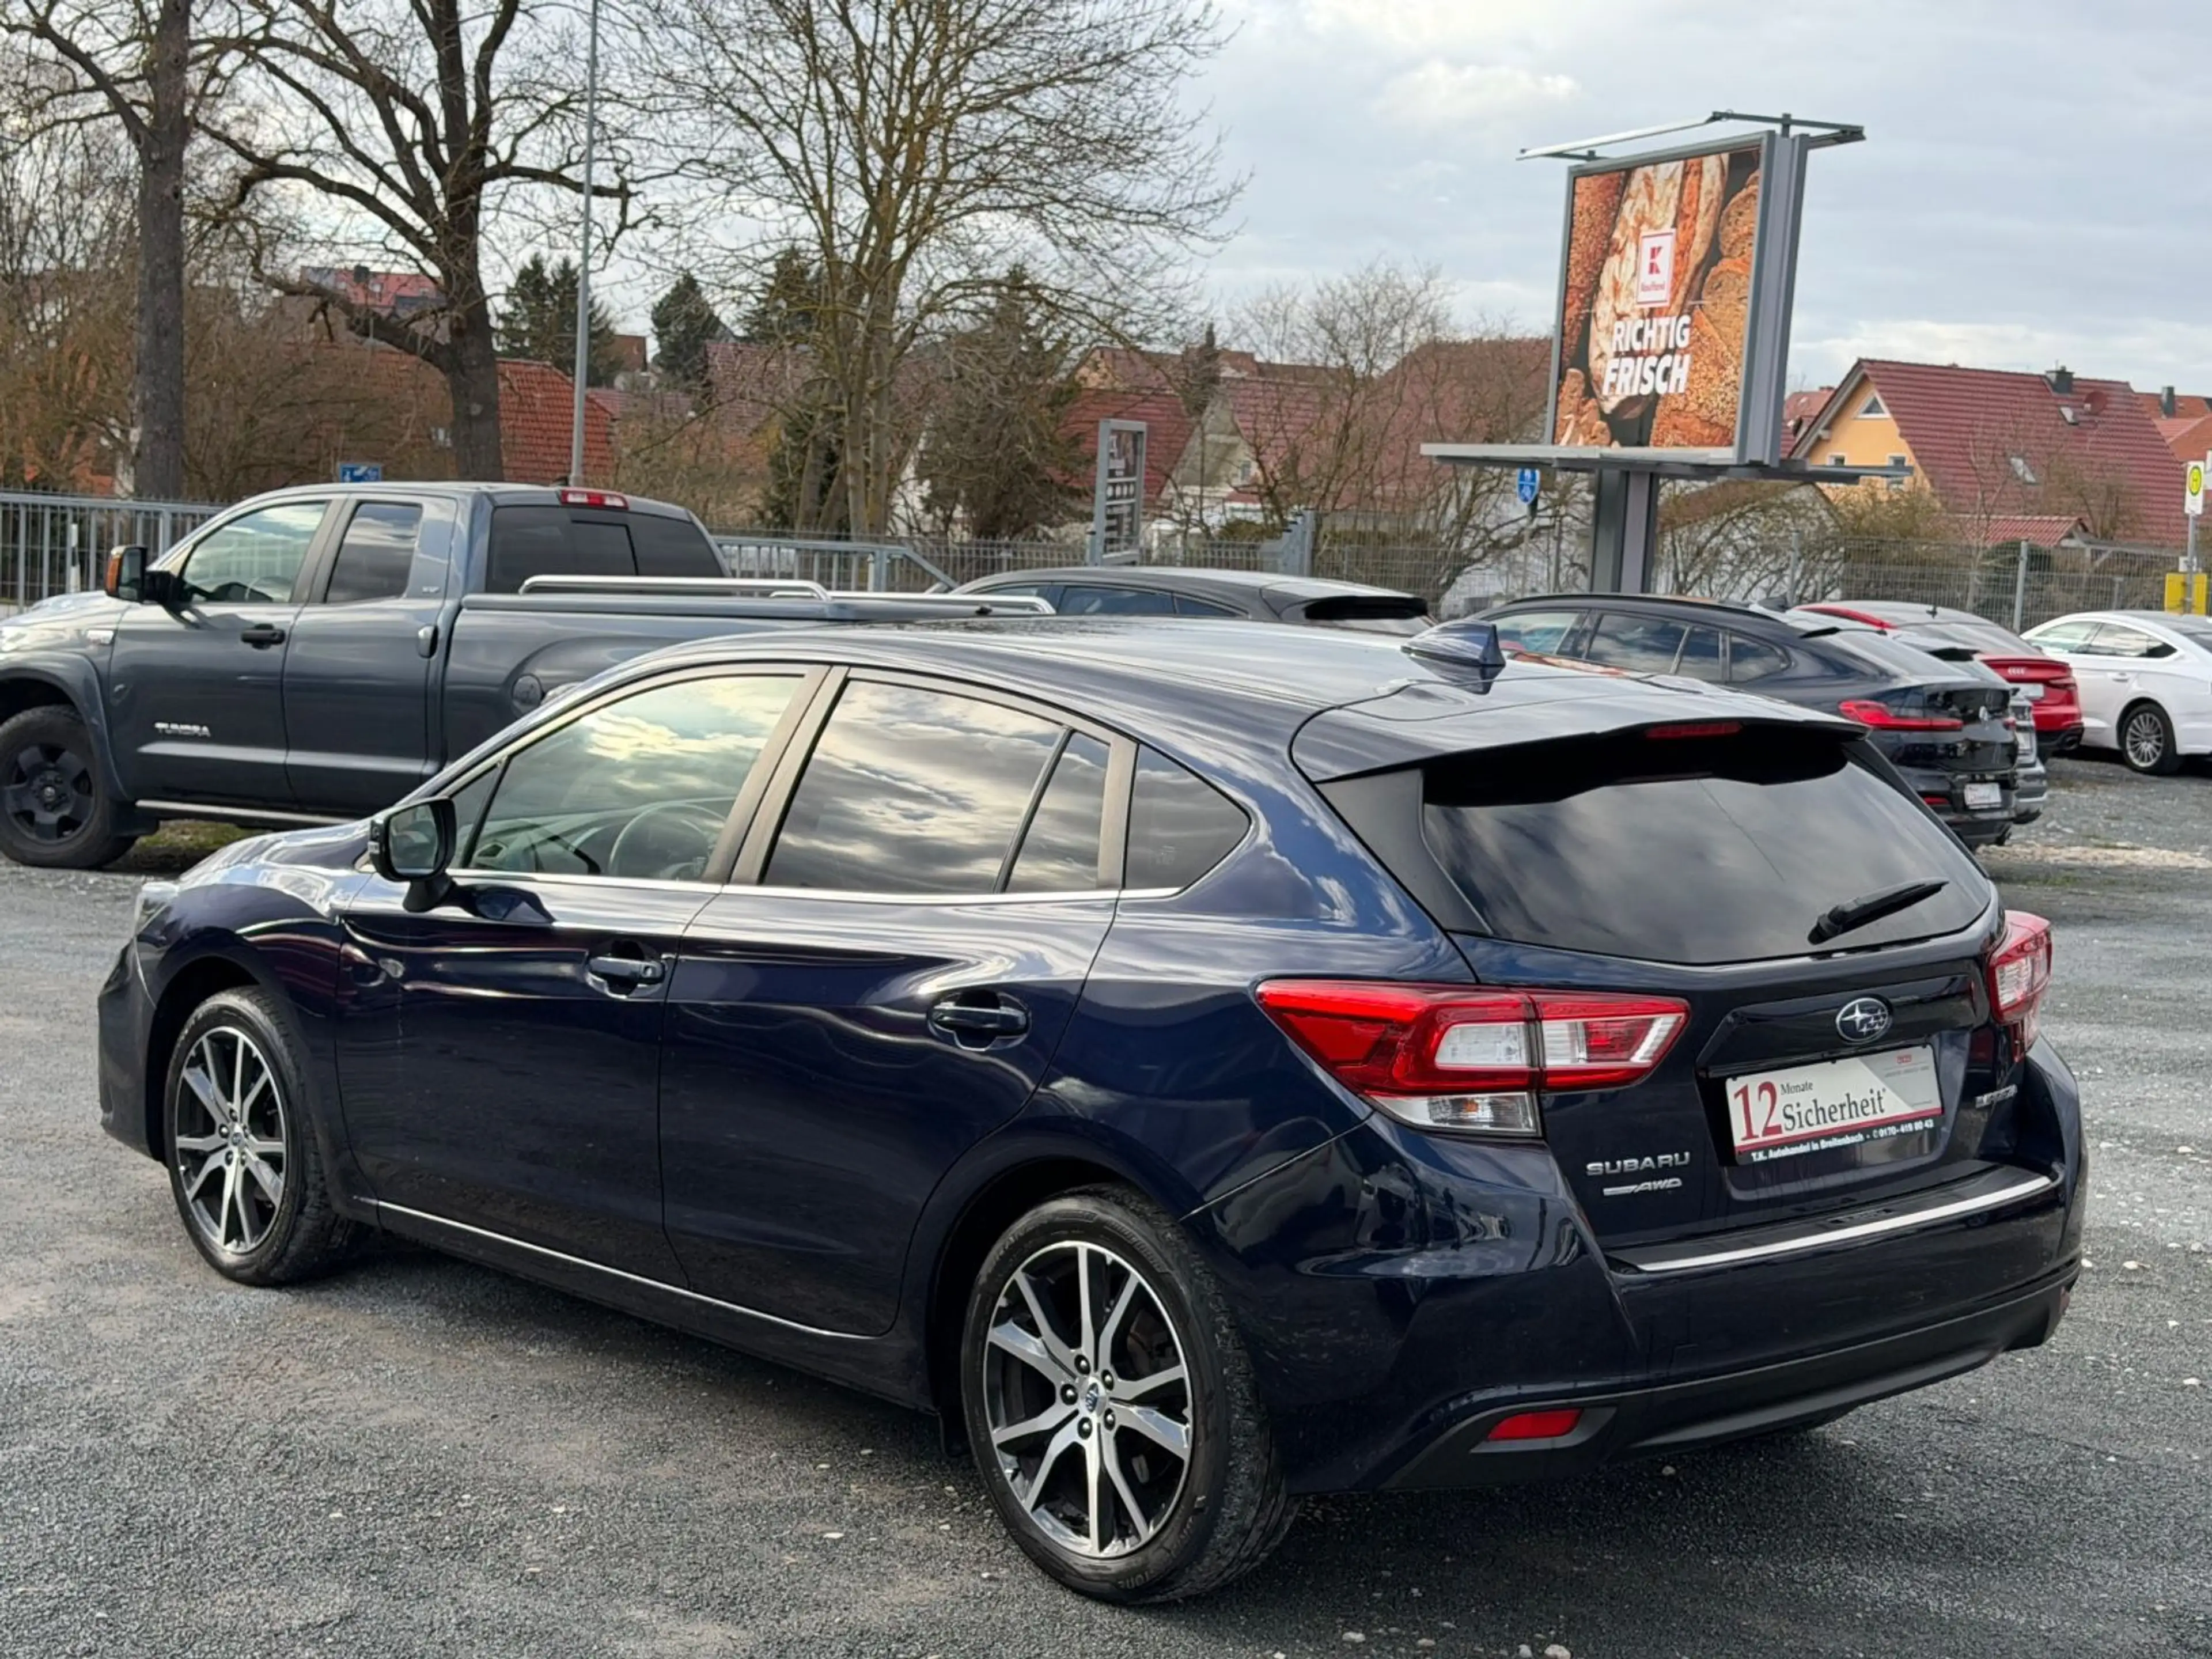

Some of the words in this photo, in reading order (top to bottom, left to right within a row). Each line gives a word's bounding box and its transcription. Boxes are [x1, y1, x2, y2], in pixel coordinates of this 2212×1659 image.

[1613, 315, 1691, 351] RICHTIG
[1603, 354, 1691, 396] FRISCH
[1780, 1081, 1813, 1096] Monate
[1734, 1081, 1782, 1141] 12
[1586, 1151, 1691, 1176] SUBARU
[1634, 1177, 1683, 1194] AWD
